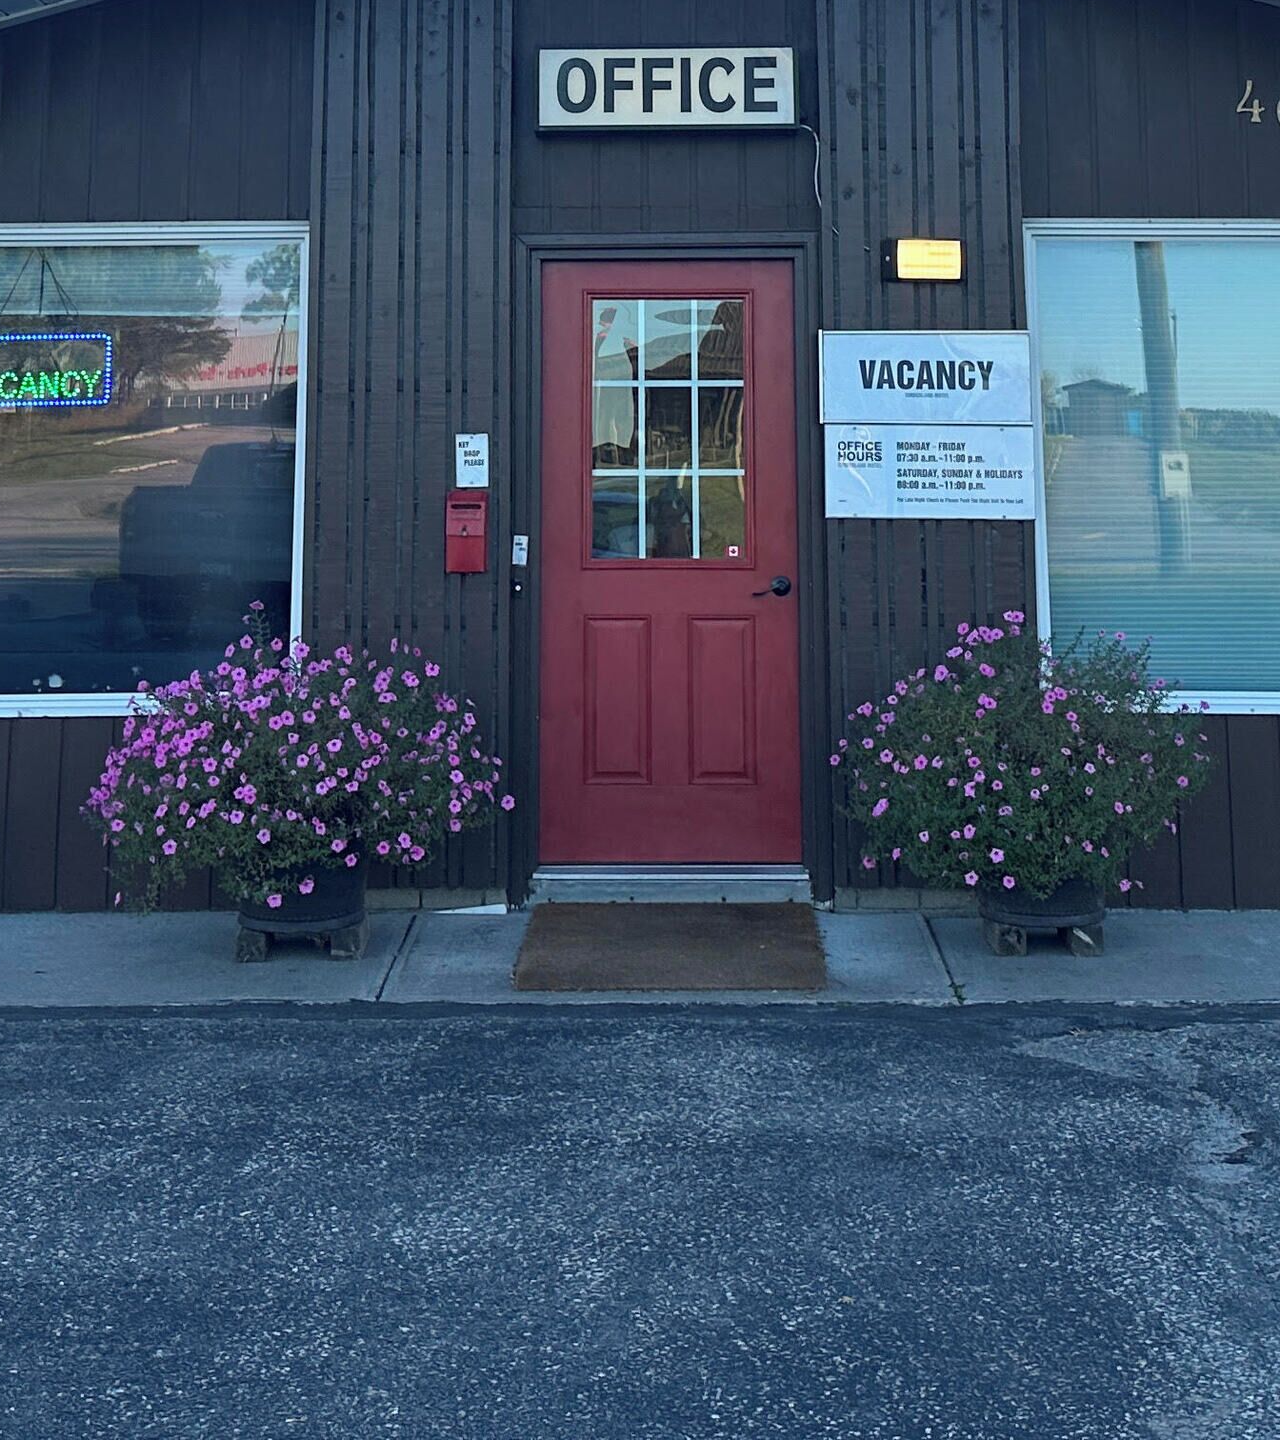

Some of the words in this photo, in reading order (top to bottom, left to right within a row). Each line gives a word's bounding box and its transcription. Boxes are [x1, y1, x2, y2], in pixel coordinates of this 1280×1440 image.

[556, 56, 779, 113] OFFICE
[859, 360, 994, 390] VACANCY
[838, 441, 882, 451] OFFICE
[897, 442, 930, 451] MONDAY
[938, 442, 966, 451] FRIDAY
[838, 452, 882, 461] HOURS
[897, 469, 939, 478] SATURDAY,
[942, 469, 974, 478] SUNDAY
[976, 470, 982, 478] &
[984, 470, 1023, 479] HOLIDAYS
